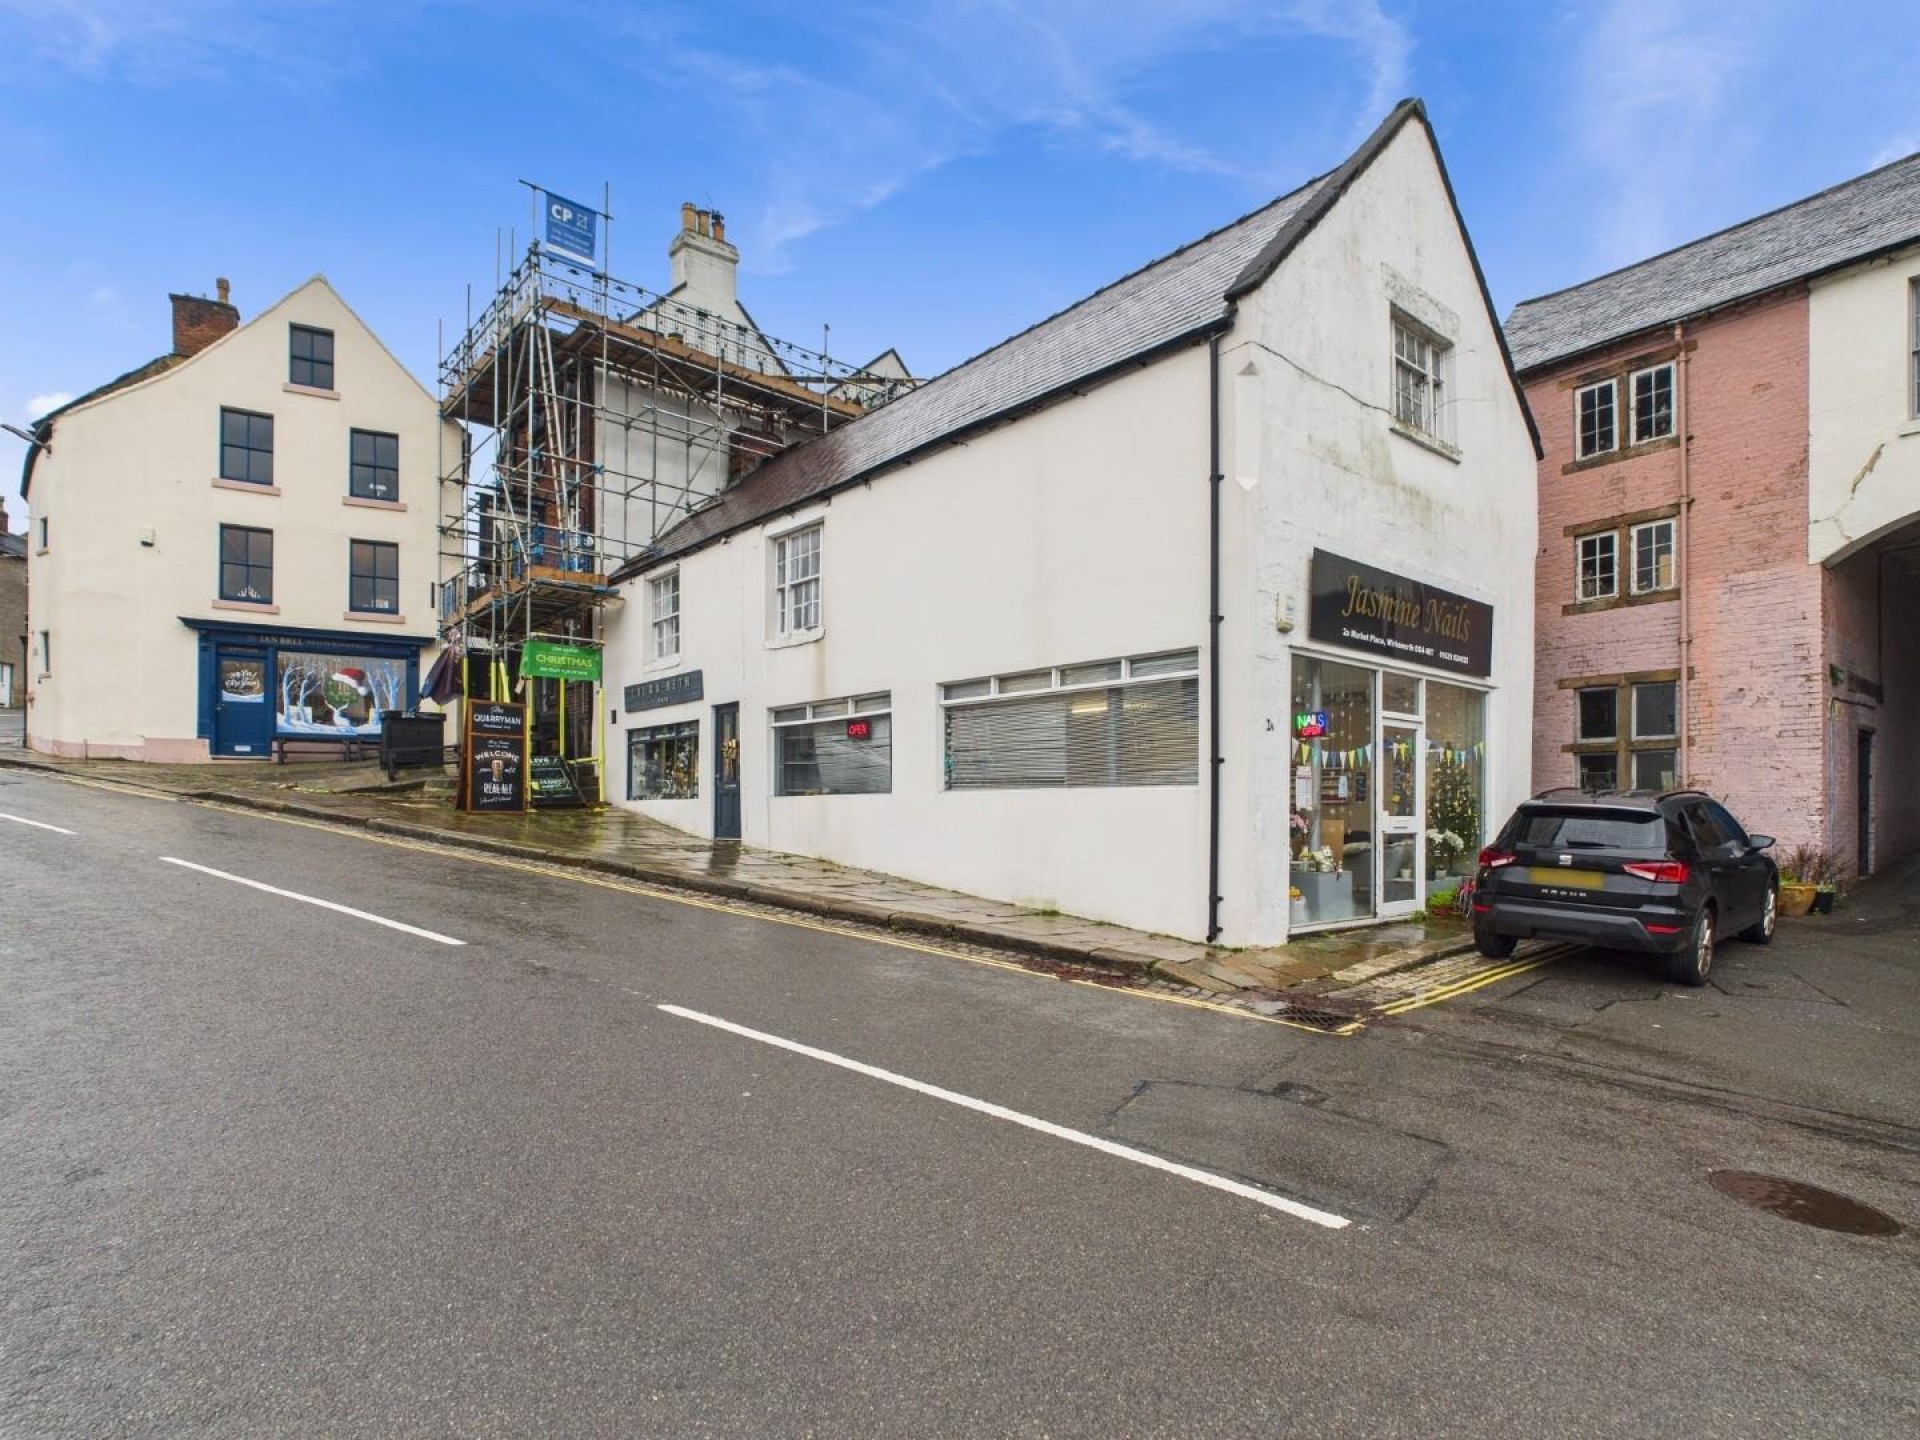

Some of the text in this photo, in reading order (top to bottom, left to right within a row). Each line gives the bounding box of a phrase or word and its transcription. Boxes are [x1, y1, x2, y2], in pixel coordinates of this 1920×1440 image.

[551, 203, 573, 223] CP
[1341, 575, 1470, 641] Jasmine Nails
[535, 654, 593, 668] CHRISTMAS
[473, 714, 521, 725] QUARRYMAN
[1296, 714, 1325, 729] NAILS
[848, 724, 868, 735] OPEN
[1302, 726, 1321, 737] OPEN
[474, 750, 520, 763] WELCOME
